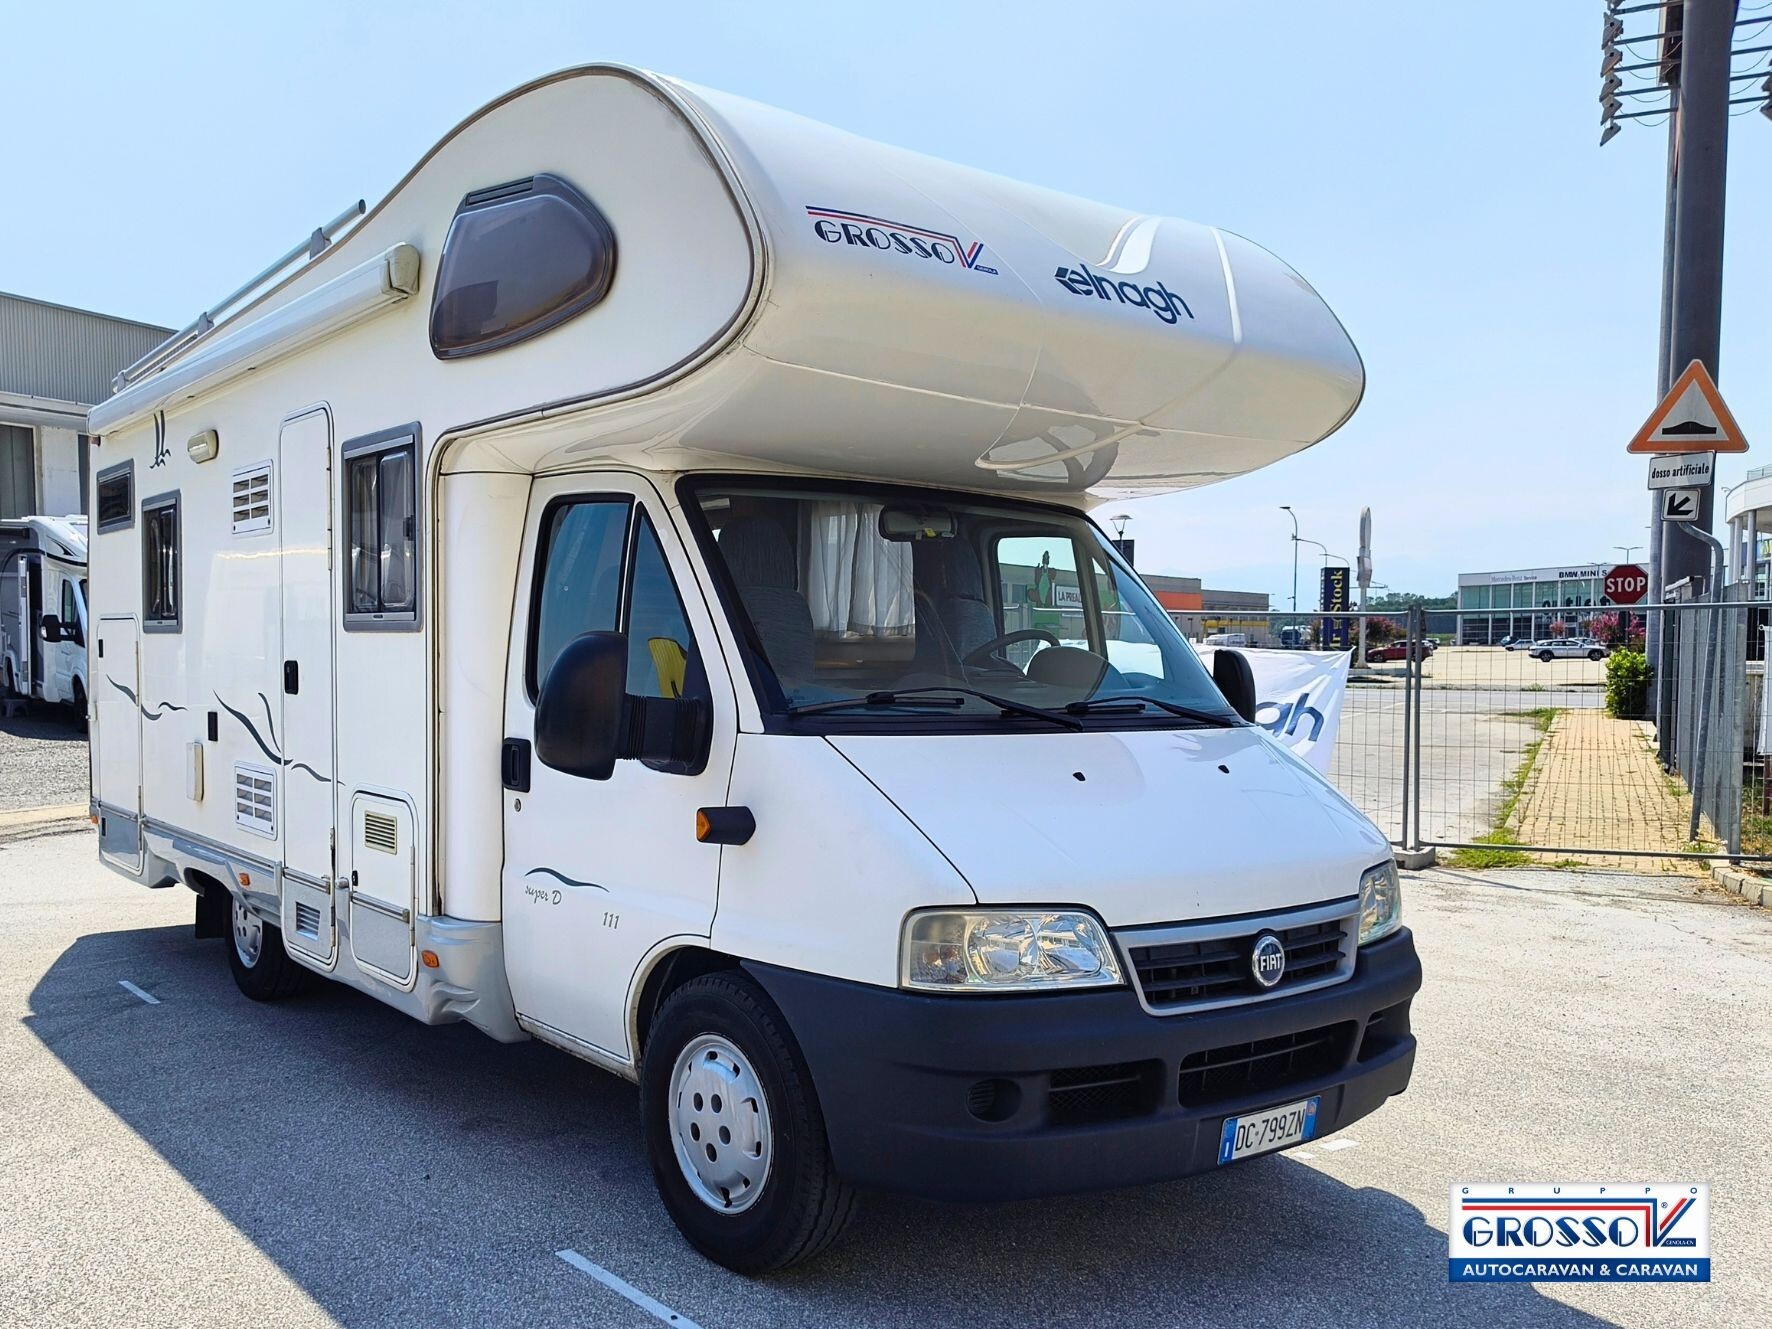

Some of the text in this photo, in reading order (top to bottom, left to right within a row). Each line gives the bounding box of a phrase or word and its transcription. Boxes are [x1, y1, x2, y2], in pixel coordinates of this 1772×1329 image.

[814, 219, 955, 265] GROSSO
[1060, 263, 1195, 325] elnagh
[1651, 463, 1710, 479] dosso artificiale
[1558, 570, 1579, 579] BMW
[1580, 569, 1599, 578] MINI
[1330, 570, 1343, 613] Stock
[1606, 576, 1646, 593] STOP
[551, 889, 563, 905] D
[602, 911, 620, 930] 111
[1260, 953, 1282, 972] FIAT
